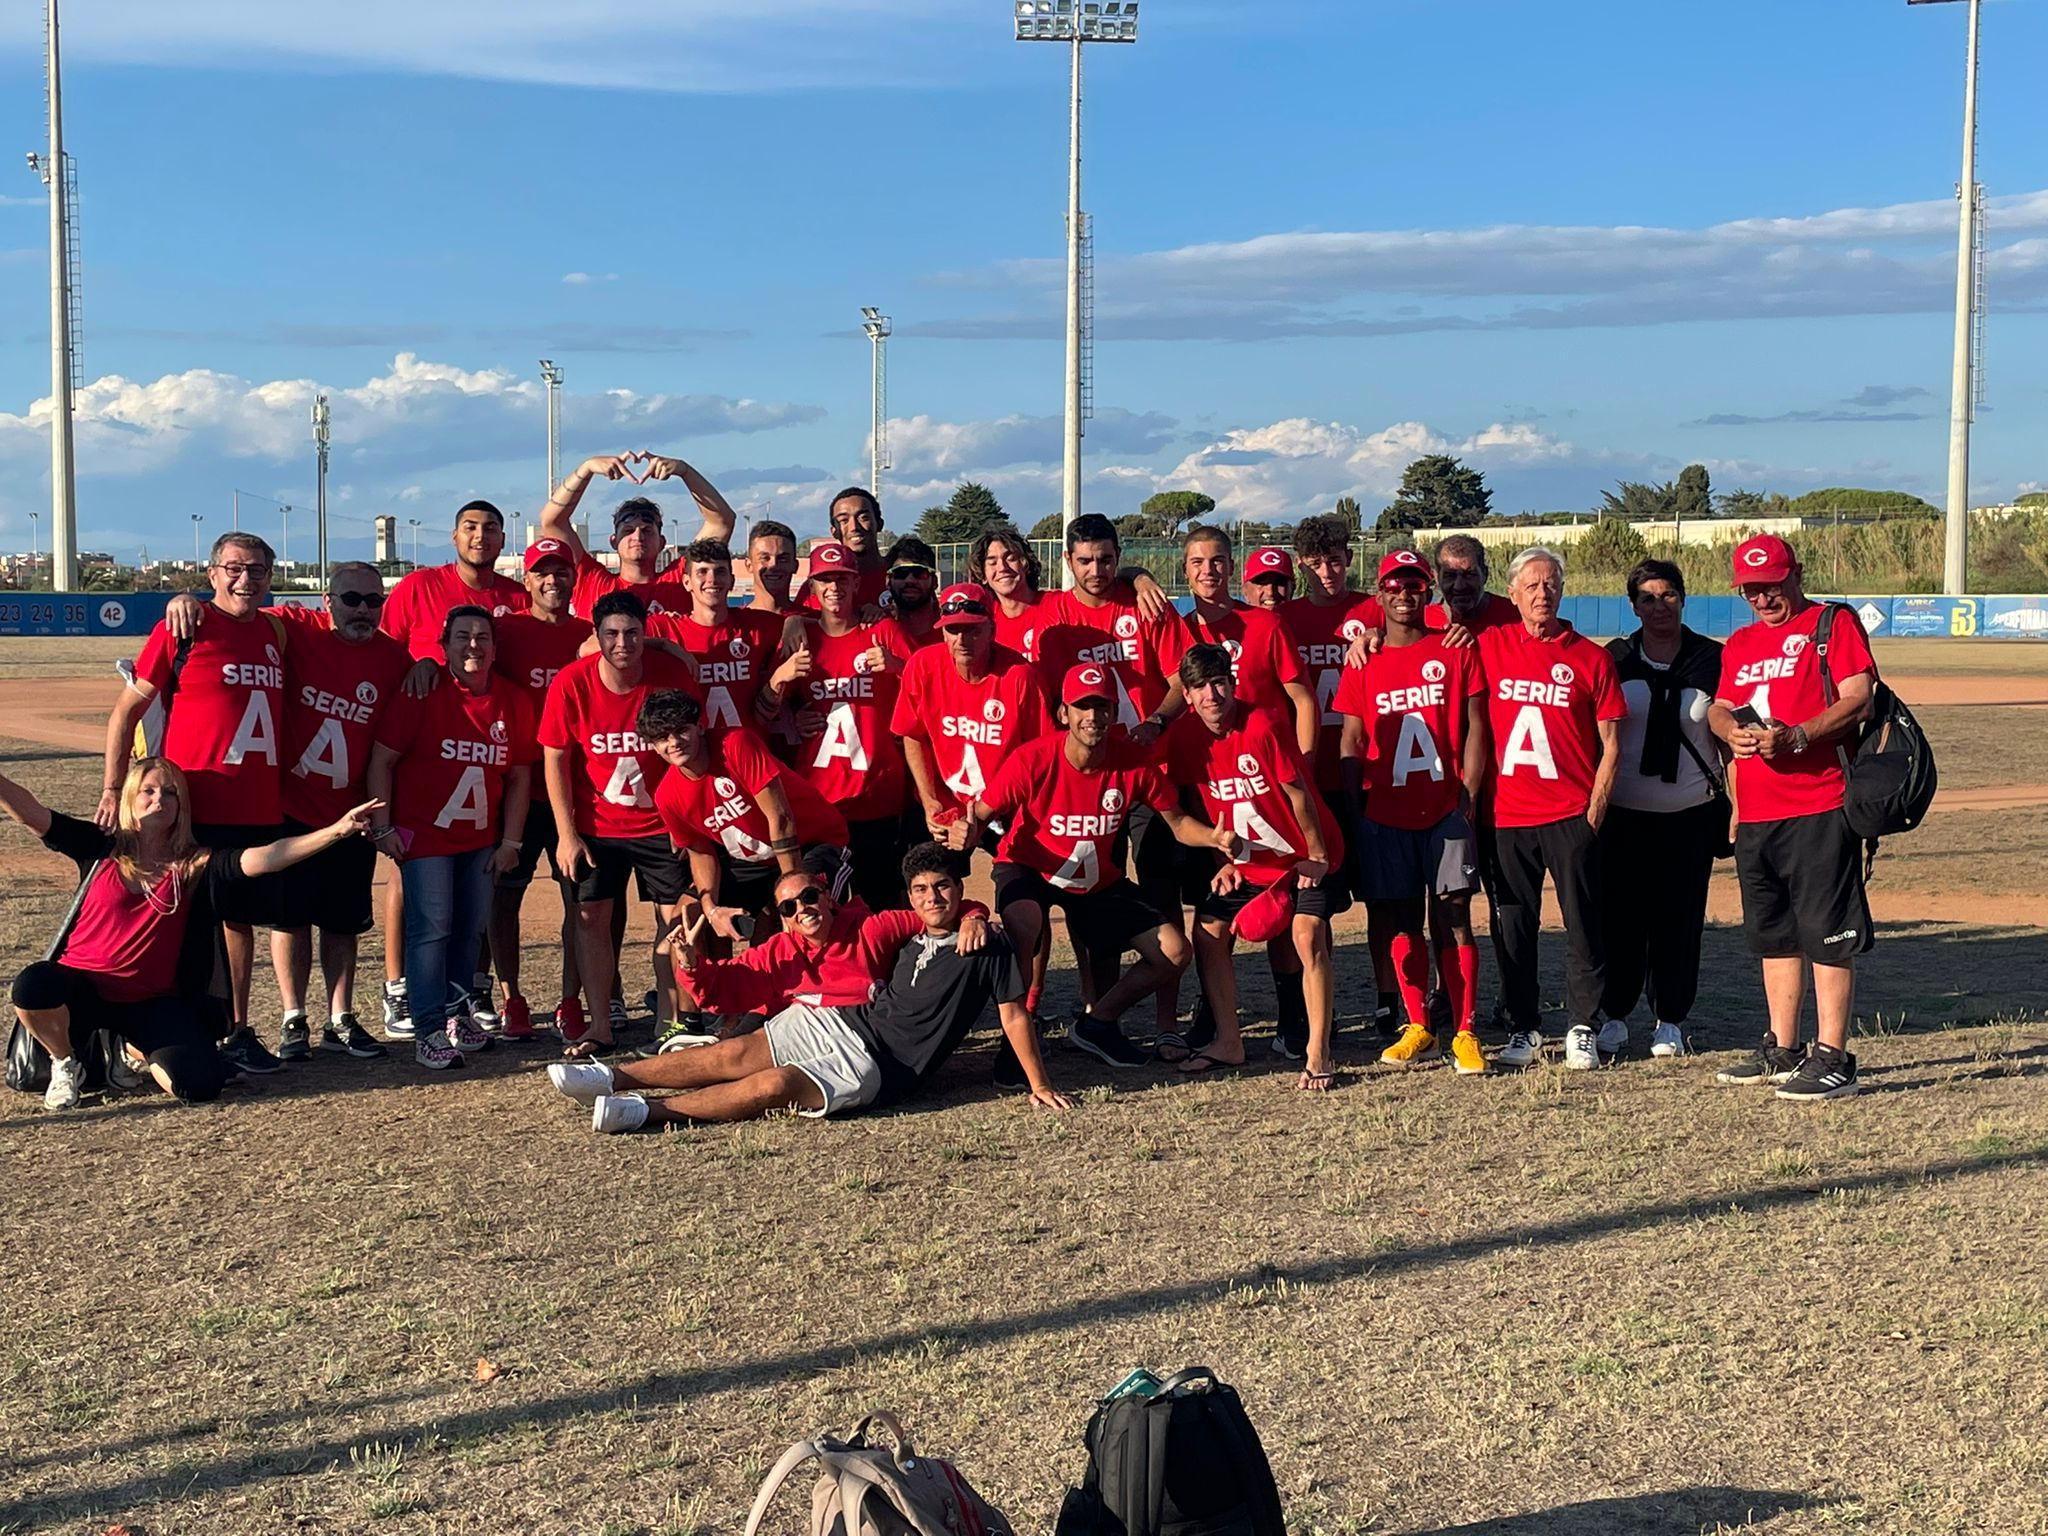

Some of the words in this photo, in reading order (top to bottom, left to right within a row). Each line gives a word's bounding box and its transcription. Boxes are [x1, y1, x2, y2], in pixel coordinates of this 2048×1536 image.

[0, 604, 22, 623] 23
[31, 604, 54, 623] 24
[63, 604, 86, 623] 36
[104, 607, 121, 621] 42
[1078, 639, 1139, 664] SERIE
[1297, 644, 1351, 665] SERI
[222, 663, 283, 689] SERIE
[699, 660, 750, 684] ERIE
[1734, 657, 1799, 686] SERIE
[810, 677, 874, 700] SERIE
[1375, 684, 1445, 715] SERIE
[1498, 678, 1571, 708] SERIE
[300, 685, 374, 725] SERIE
[222, 689, 278, 766] A
[812, 702, 869, 771] A
[942, 715, 1003, 746] SERIE
[1501, 705, 1559, 780] A
[291, 717, 349, 789] A
[440, 738, 509, 766] SERIE
[1393, 711, 1445, 787] A
[603, 756, 654, 808] A
[945, 742, 987, 800] A
[433, 765, 488, 830] A
[1208, 774, 1271, 801] SERIE
[703, 794, 752, 833] SRIE
[1049, 813, 1121, 837] SERIE
[720, 825, 776, 862] A
[1232, 801, 1296, 865] A
[1048, 840, 1100, 892] A
